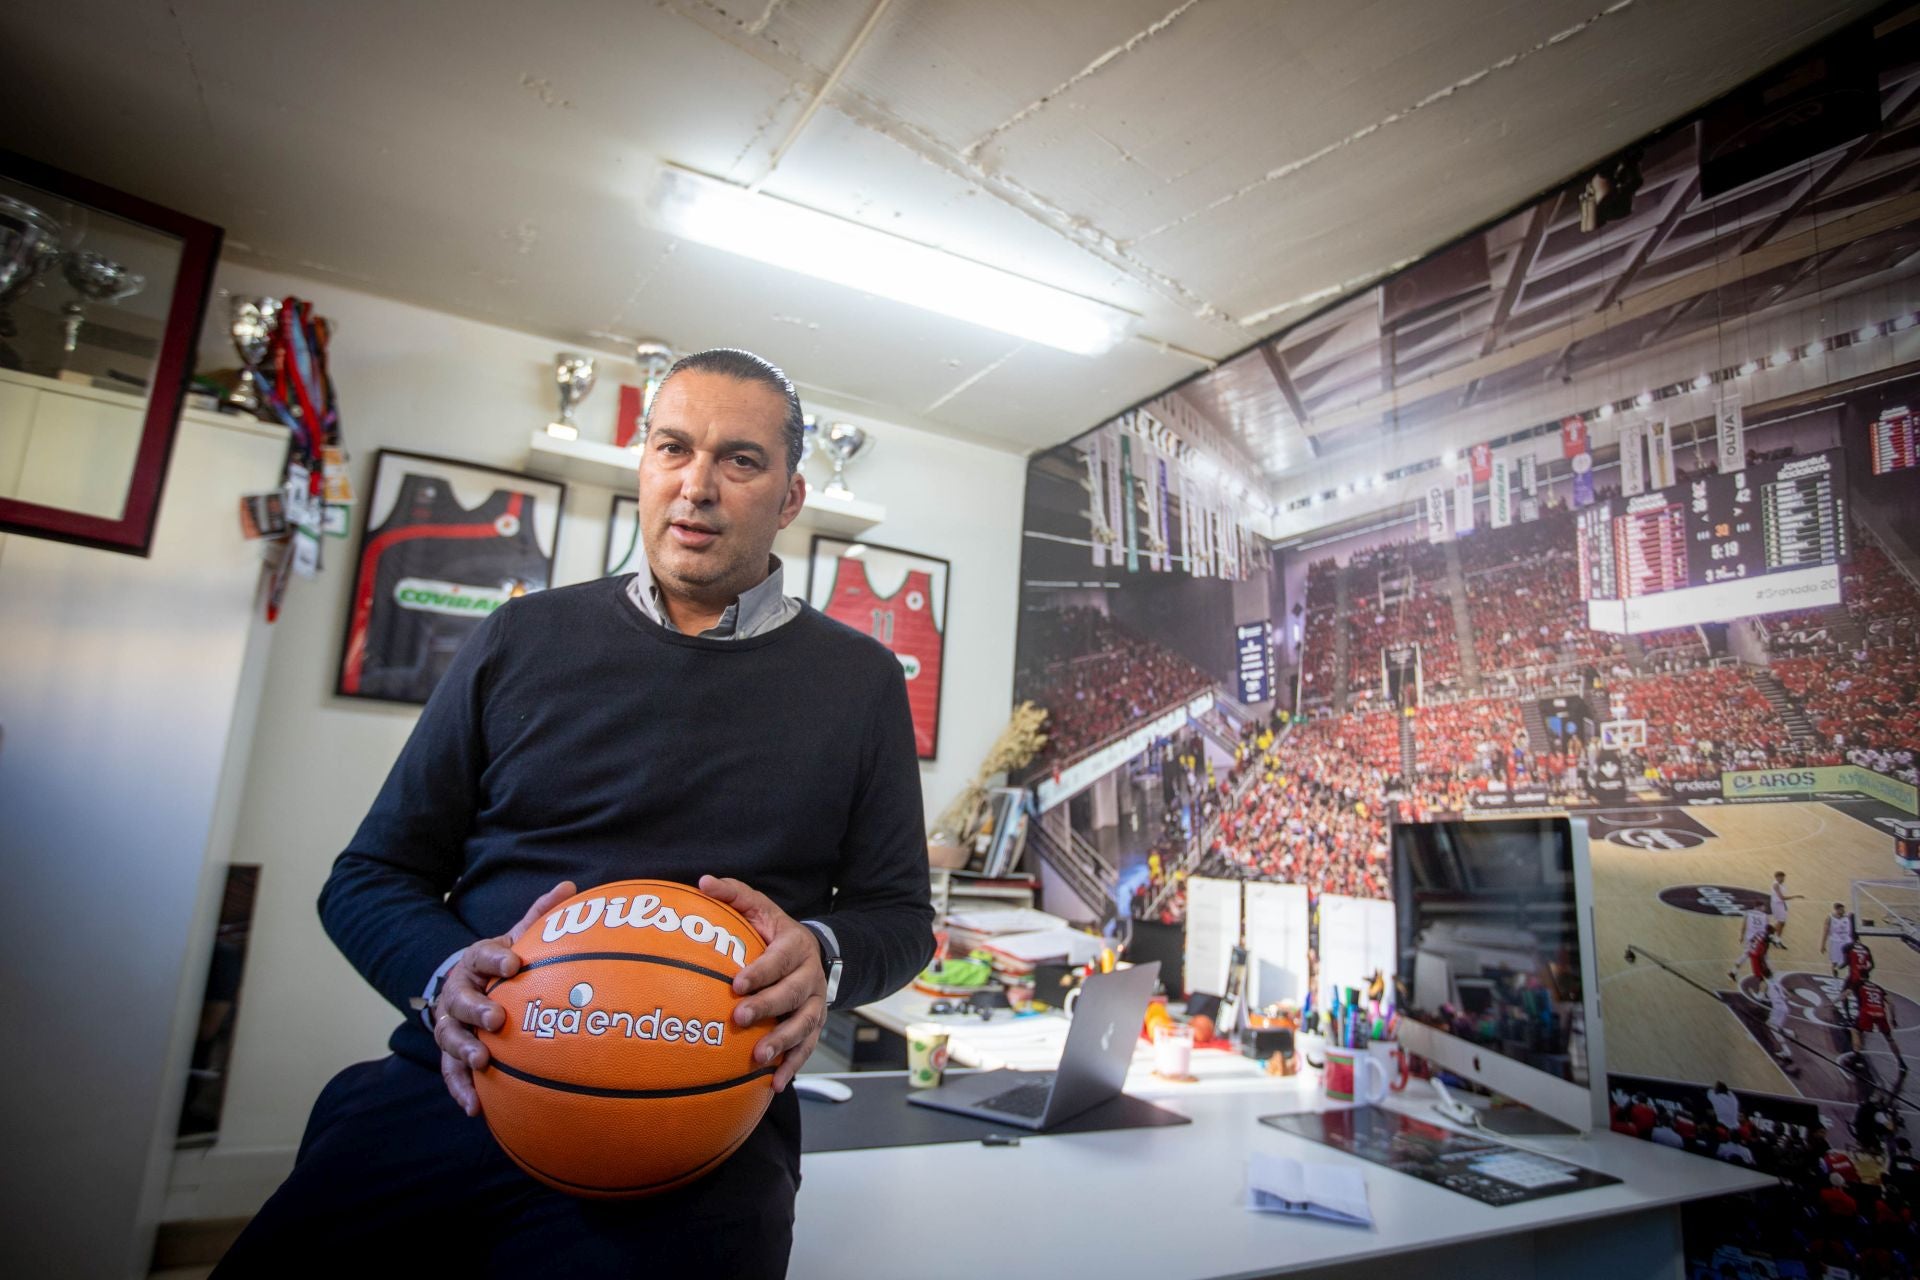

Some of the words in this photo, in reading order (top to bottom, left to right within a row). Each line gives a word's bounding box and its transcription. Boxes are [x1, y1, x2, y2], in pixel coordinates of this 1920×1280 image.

[1430, 488, 1443, 532] Jeep
[872, 608, 894, 644] 11
[542, 894, 747, 967] Wilson
[522, 999, 582, 1039] liga
[586, 1008, 725, 1047] endesa
